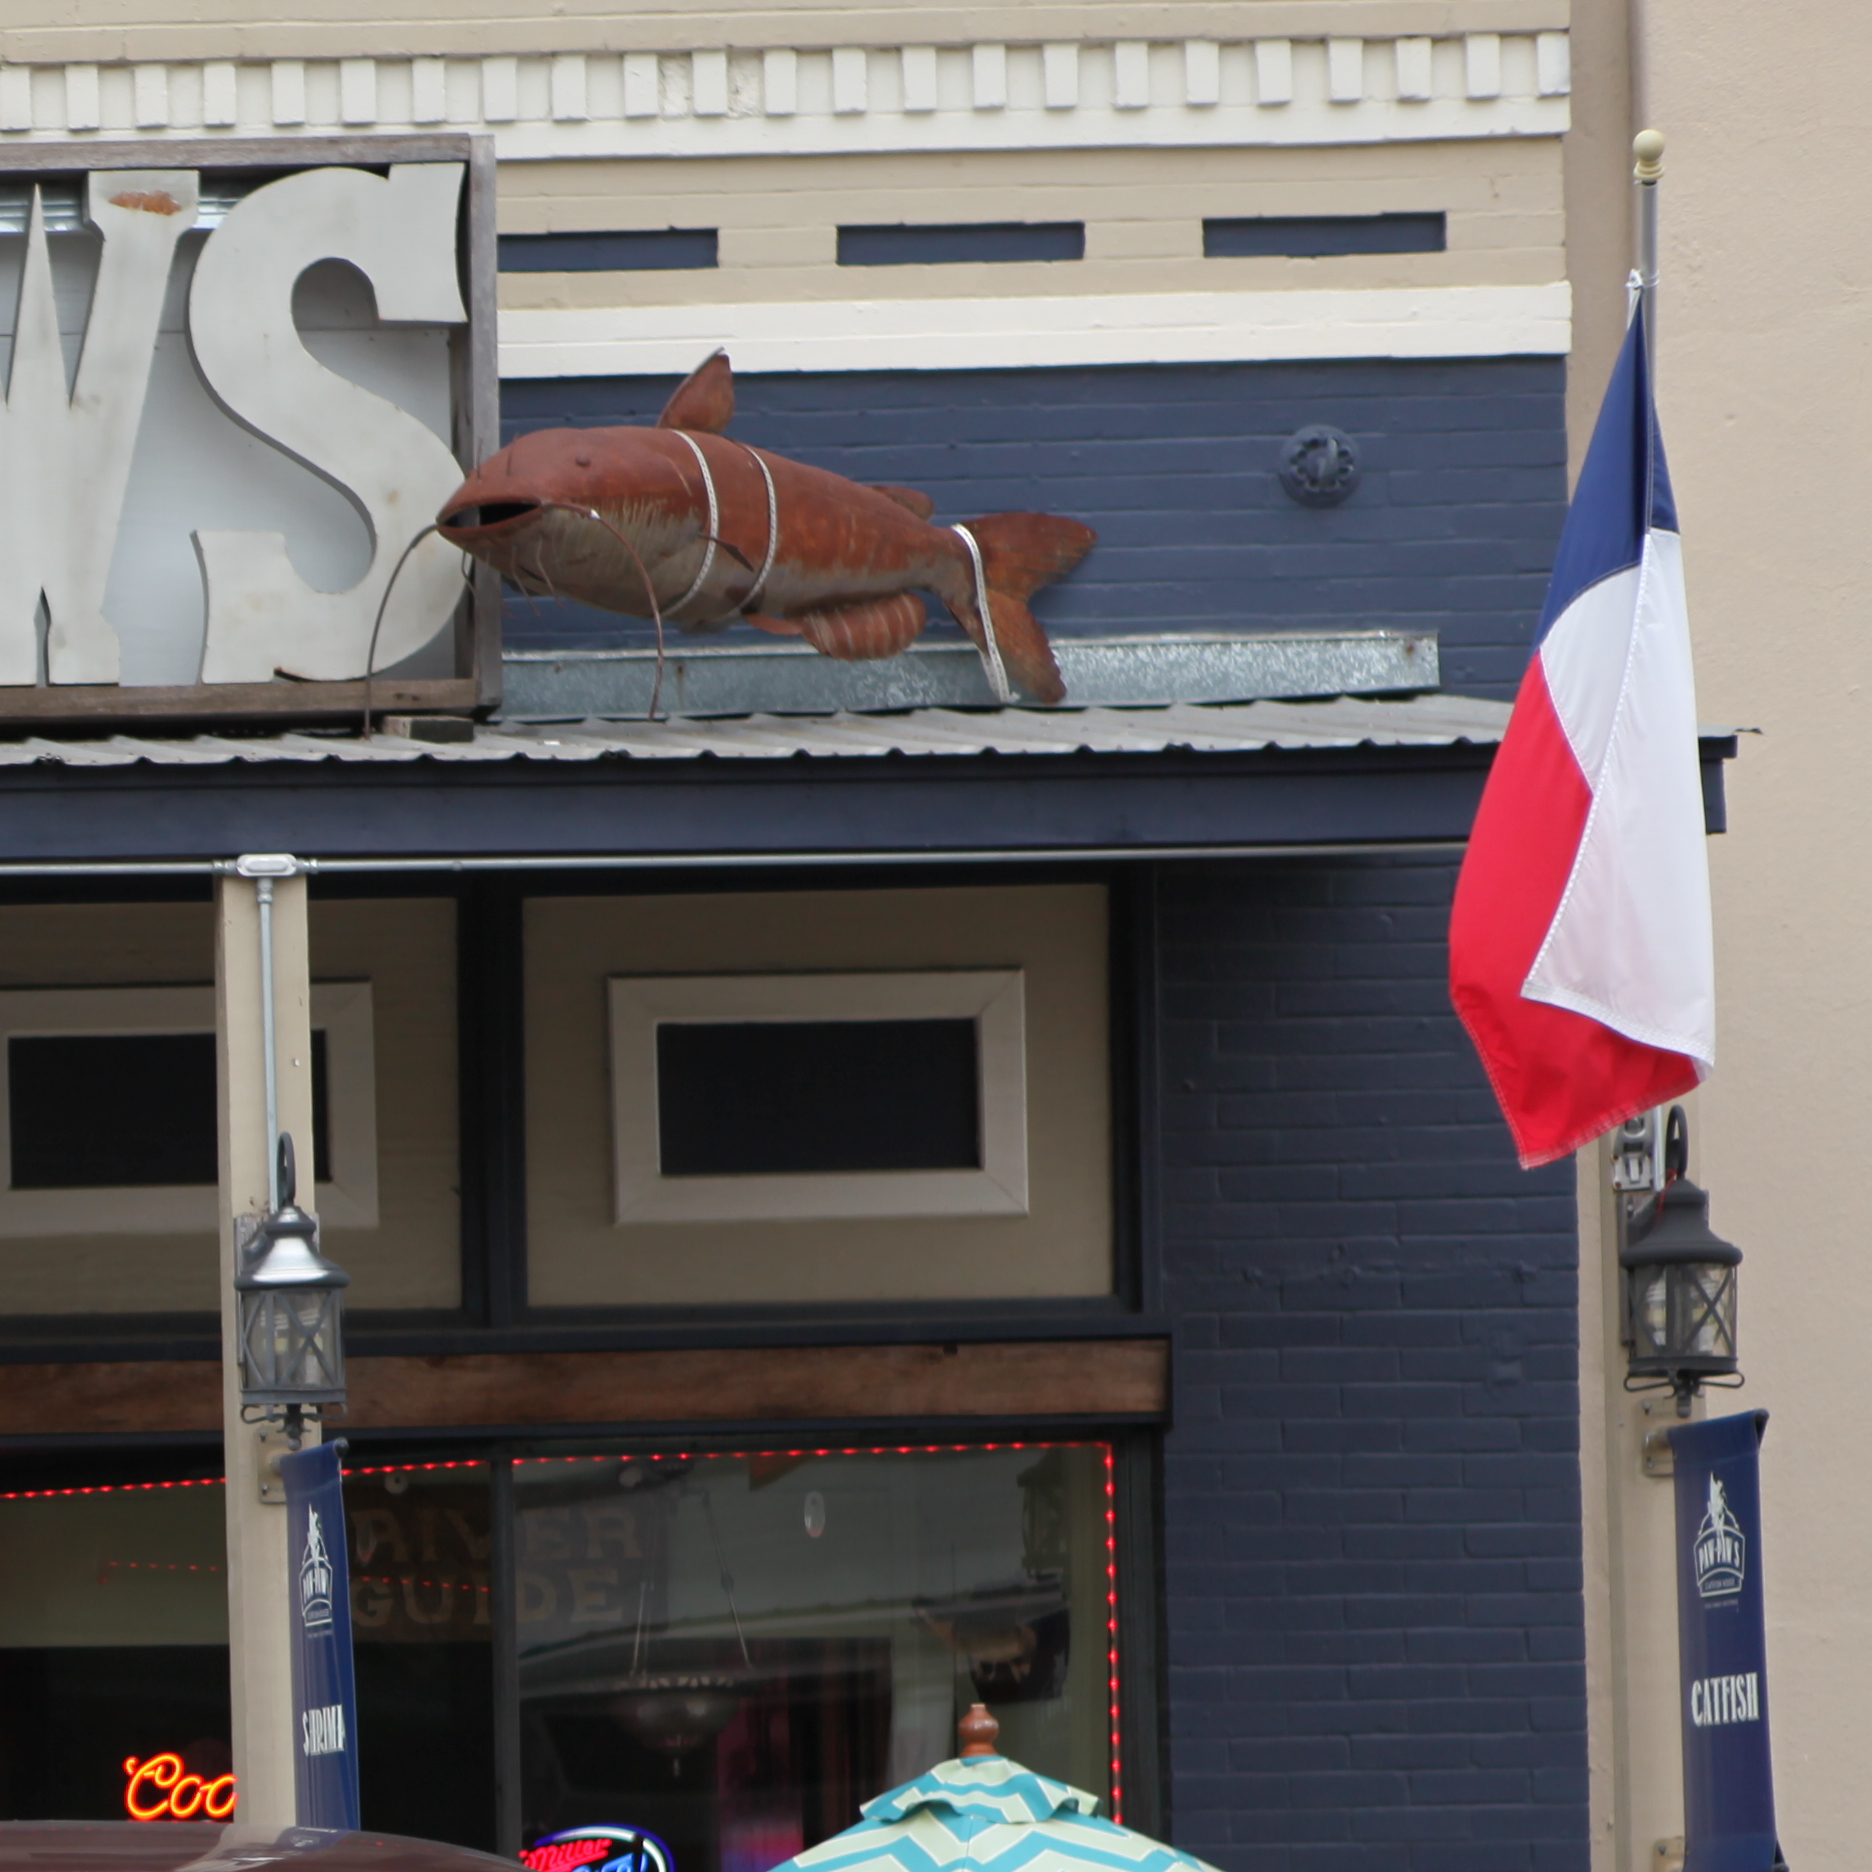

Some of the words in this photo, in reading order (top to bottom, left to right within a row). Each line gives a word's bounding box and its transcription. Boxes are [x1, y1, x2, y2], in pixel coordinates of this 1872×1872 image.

[350, 1566, 623, 1627] GUIDE
[1690, 1671, 1759, 1728] CATFISH
[124, 1752, 237, 1819] Coo
